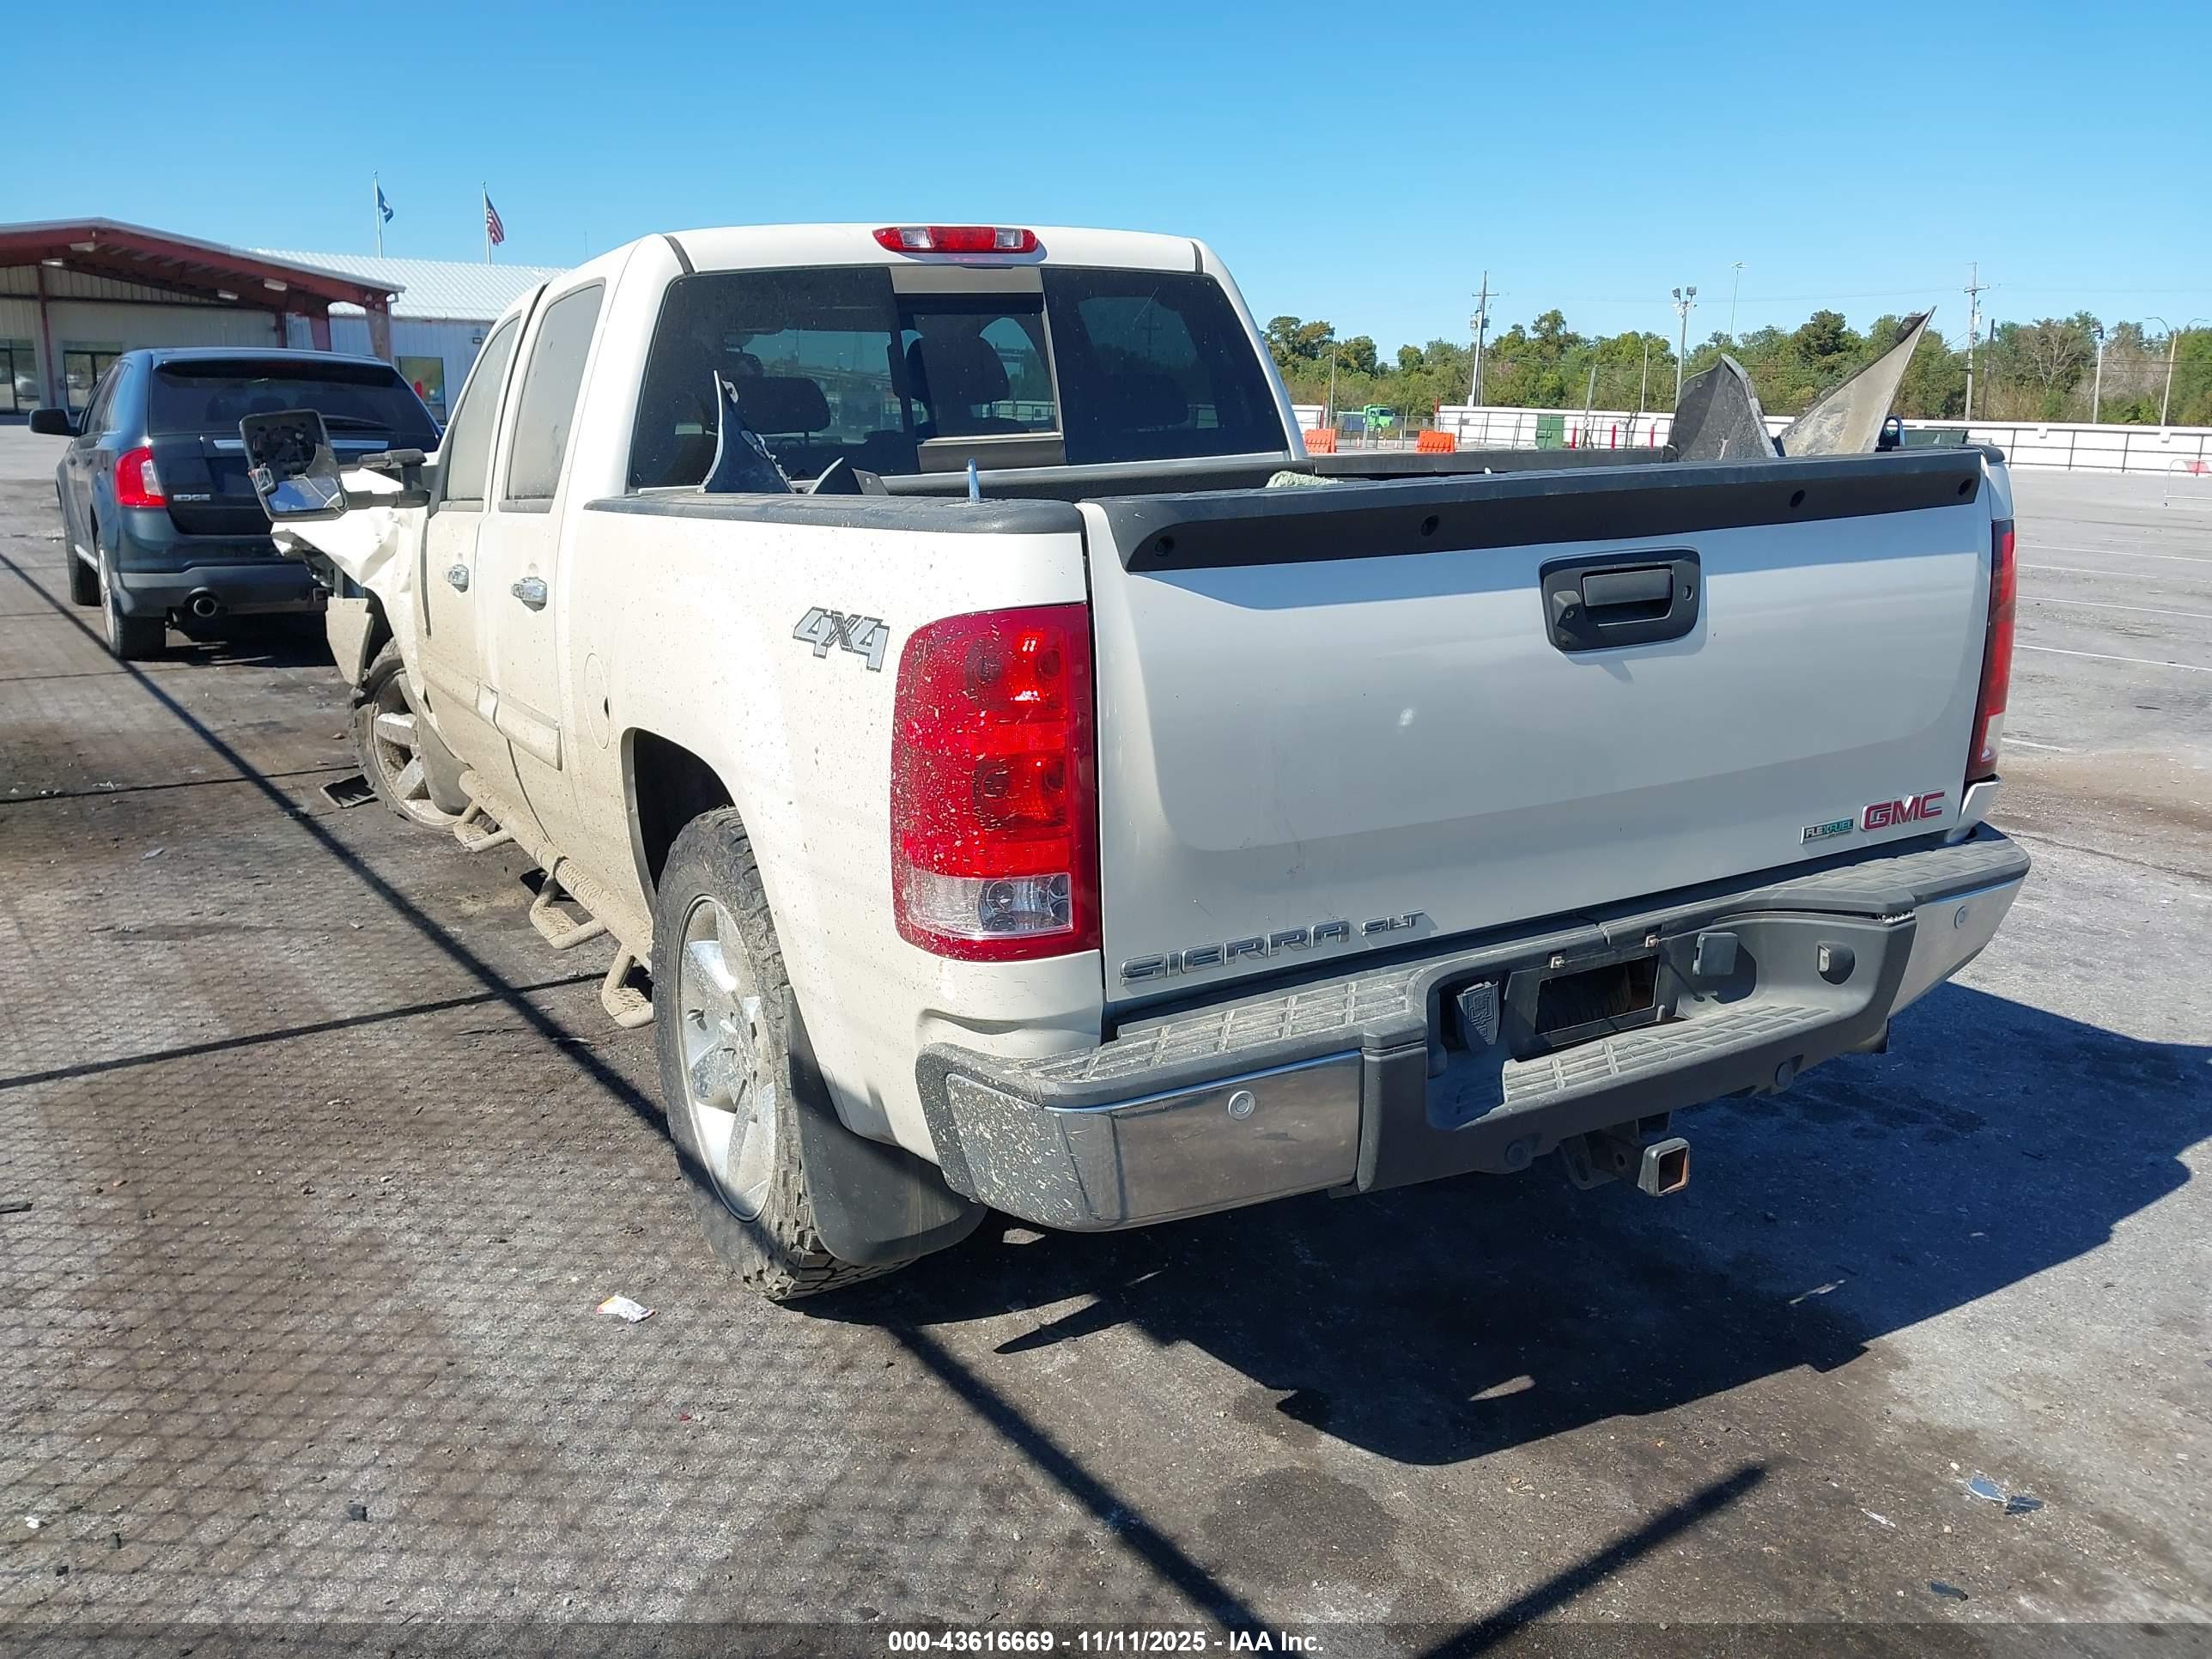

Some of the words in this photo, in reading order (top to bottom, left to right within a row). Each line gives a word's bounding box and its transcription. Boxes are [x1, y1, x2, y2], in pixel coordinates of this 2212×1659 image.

[173, 493, 211, 502] EDGE
[1861, 790, 1945, 831] GMC
[1120, 918, 1349, 986] SIERRA
[1361, 909, 1425, 937] SLT
